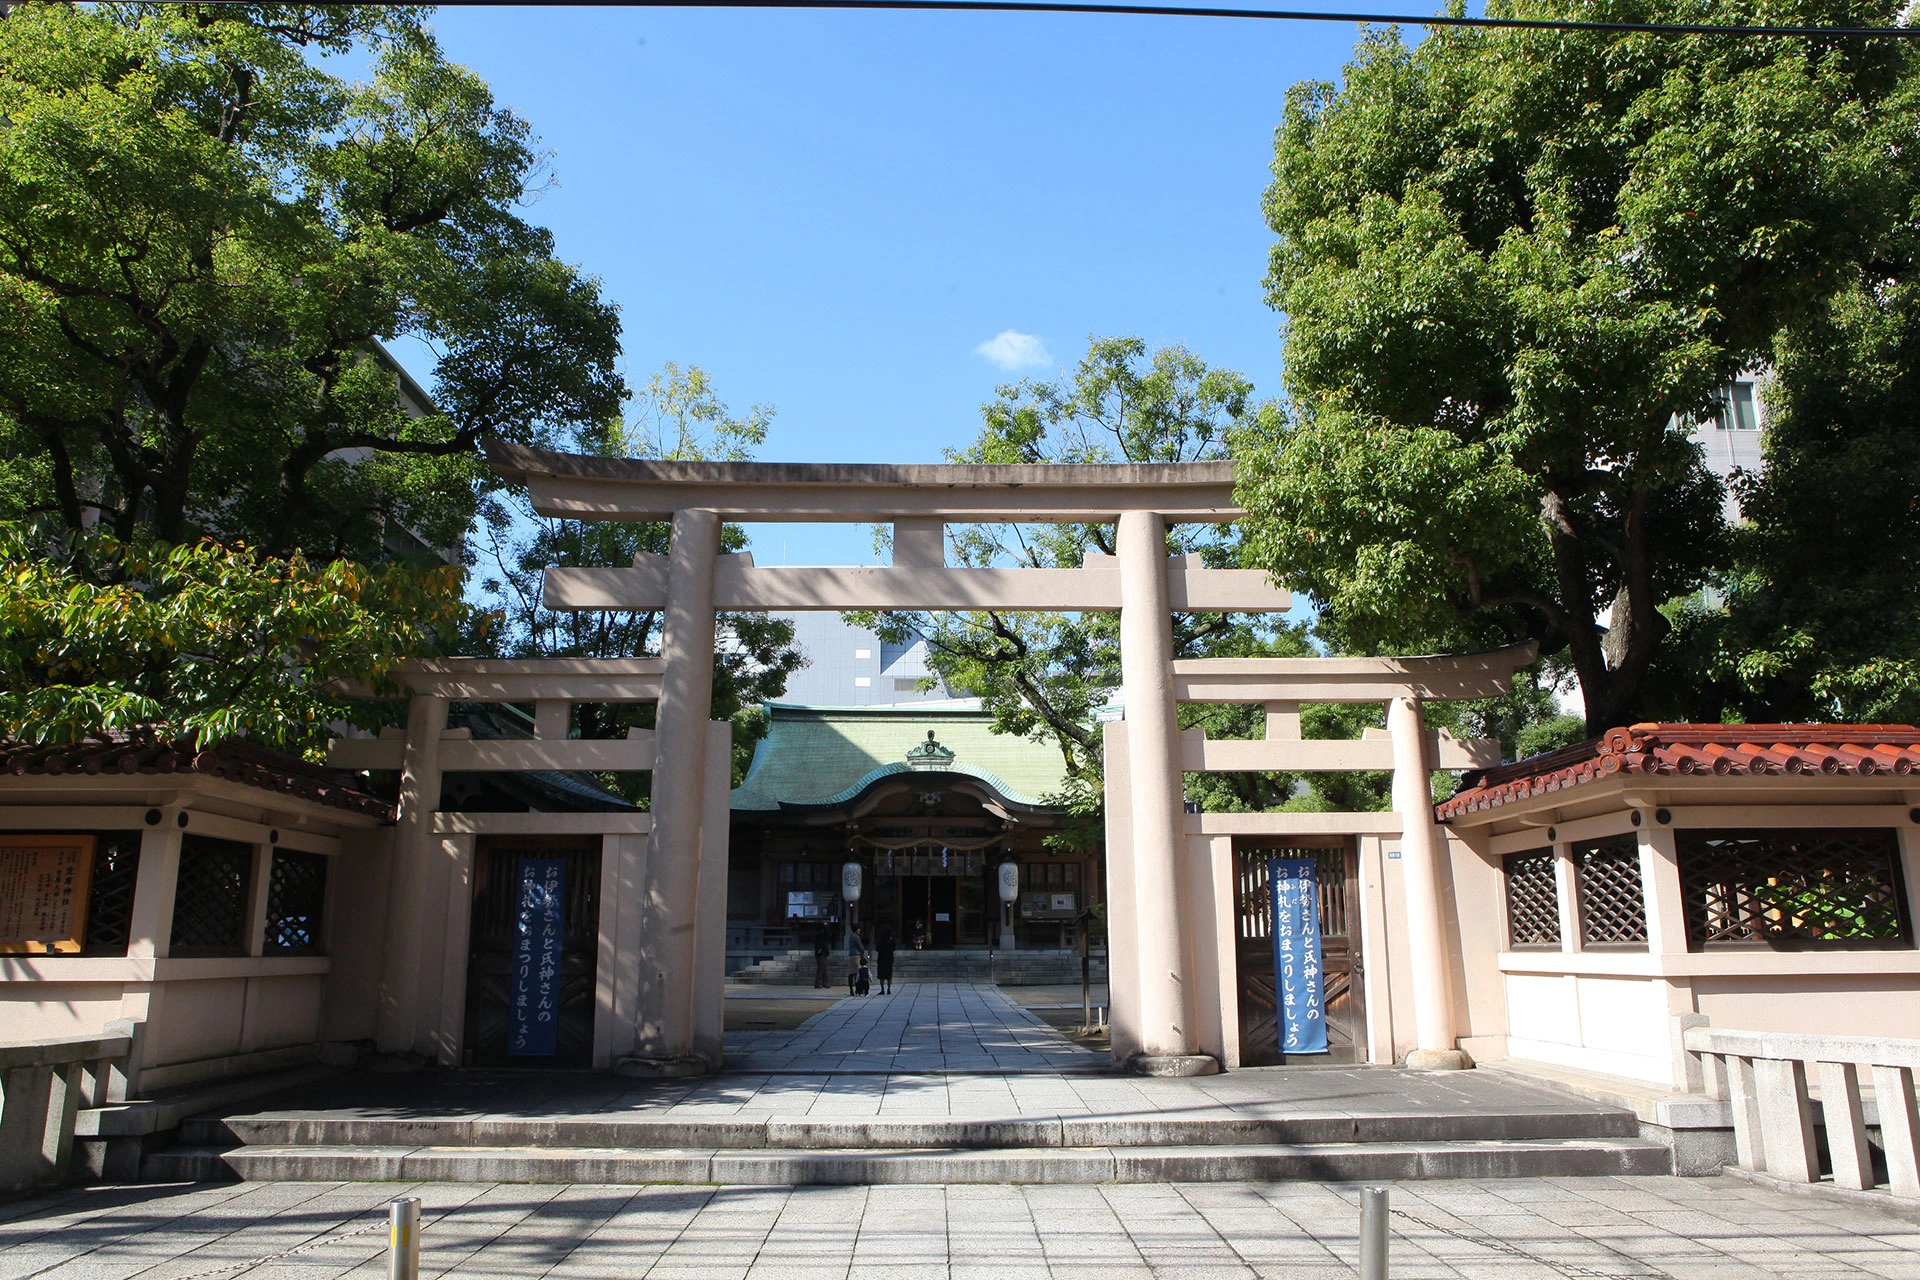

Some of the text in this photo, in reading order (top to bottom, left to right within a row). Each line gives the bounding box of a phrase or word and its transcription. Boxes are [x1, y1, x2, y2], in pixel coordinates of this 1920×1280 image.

[515, 866, 536, 1049] お神札をおまつりしましょう
[537, 866, 559, 1022] お伊勢さんと氏神さんの
[1276, 866, 1300, 1048] お神札をおまつりしましょう
[1297, 866, 1320, 1021] お伊勢さんと氏神さんの
